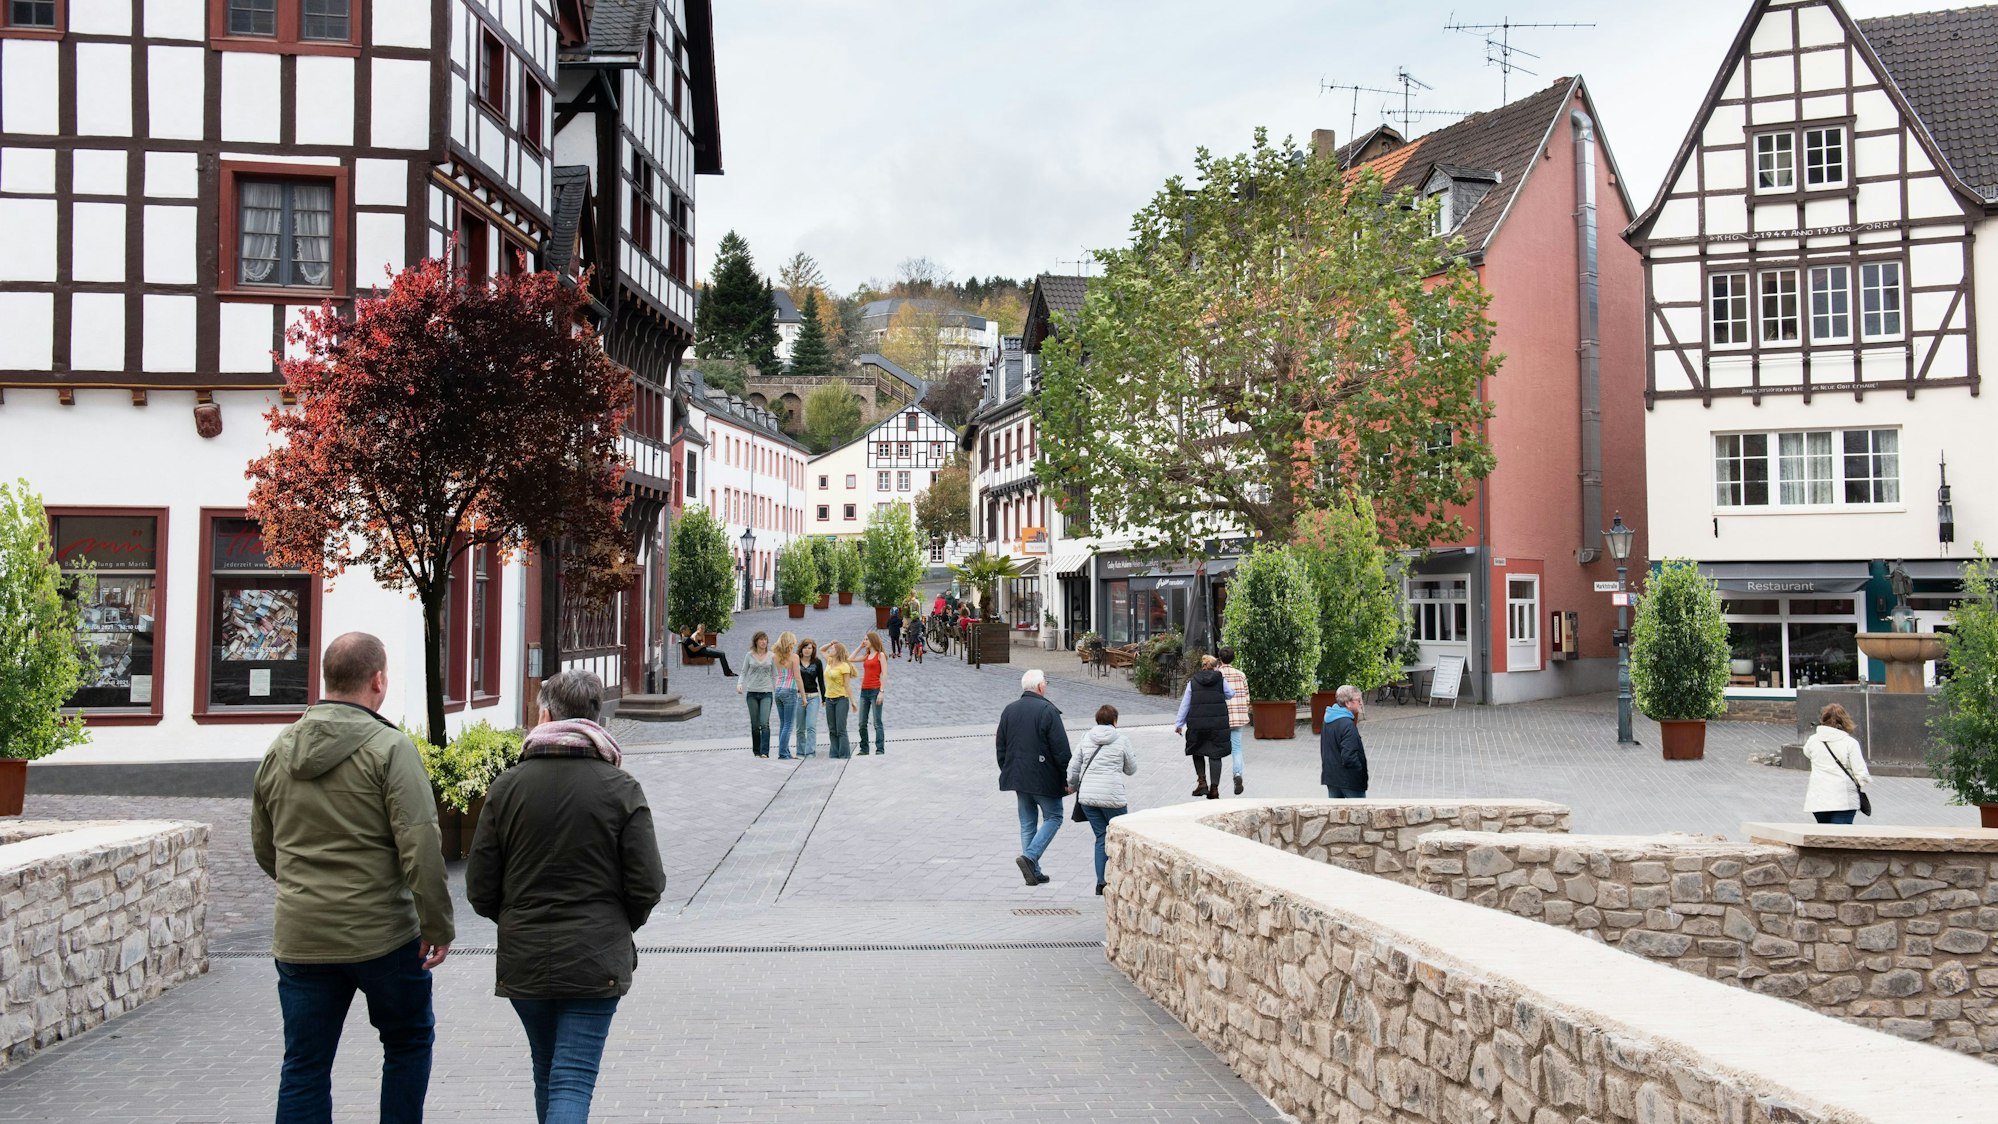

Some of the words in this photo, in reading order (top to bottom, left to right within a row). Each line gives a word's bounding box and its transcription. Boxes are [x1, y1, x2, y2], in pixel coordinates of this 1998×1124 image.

[1760, 230, 1787, 239] 1944
[1817, 226, 1844, 235] 1950
[223, 561, 252, 569] jederzeit
[1747, 581, 1815, 591] Restaurant
